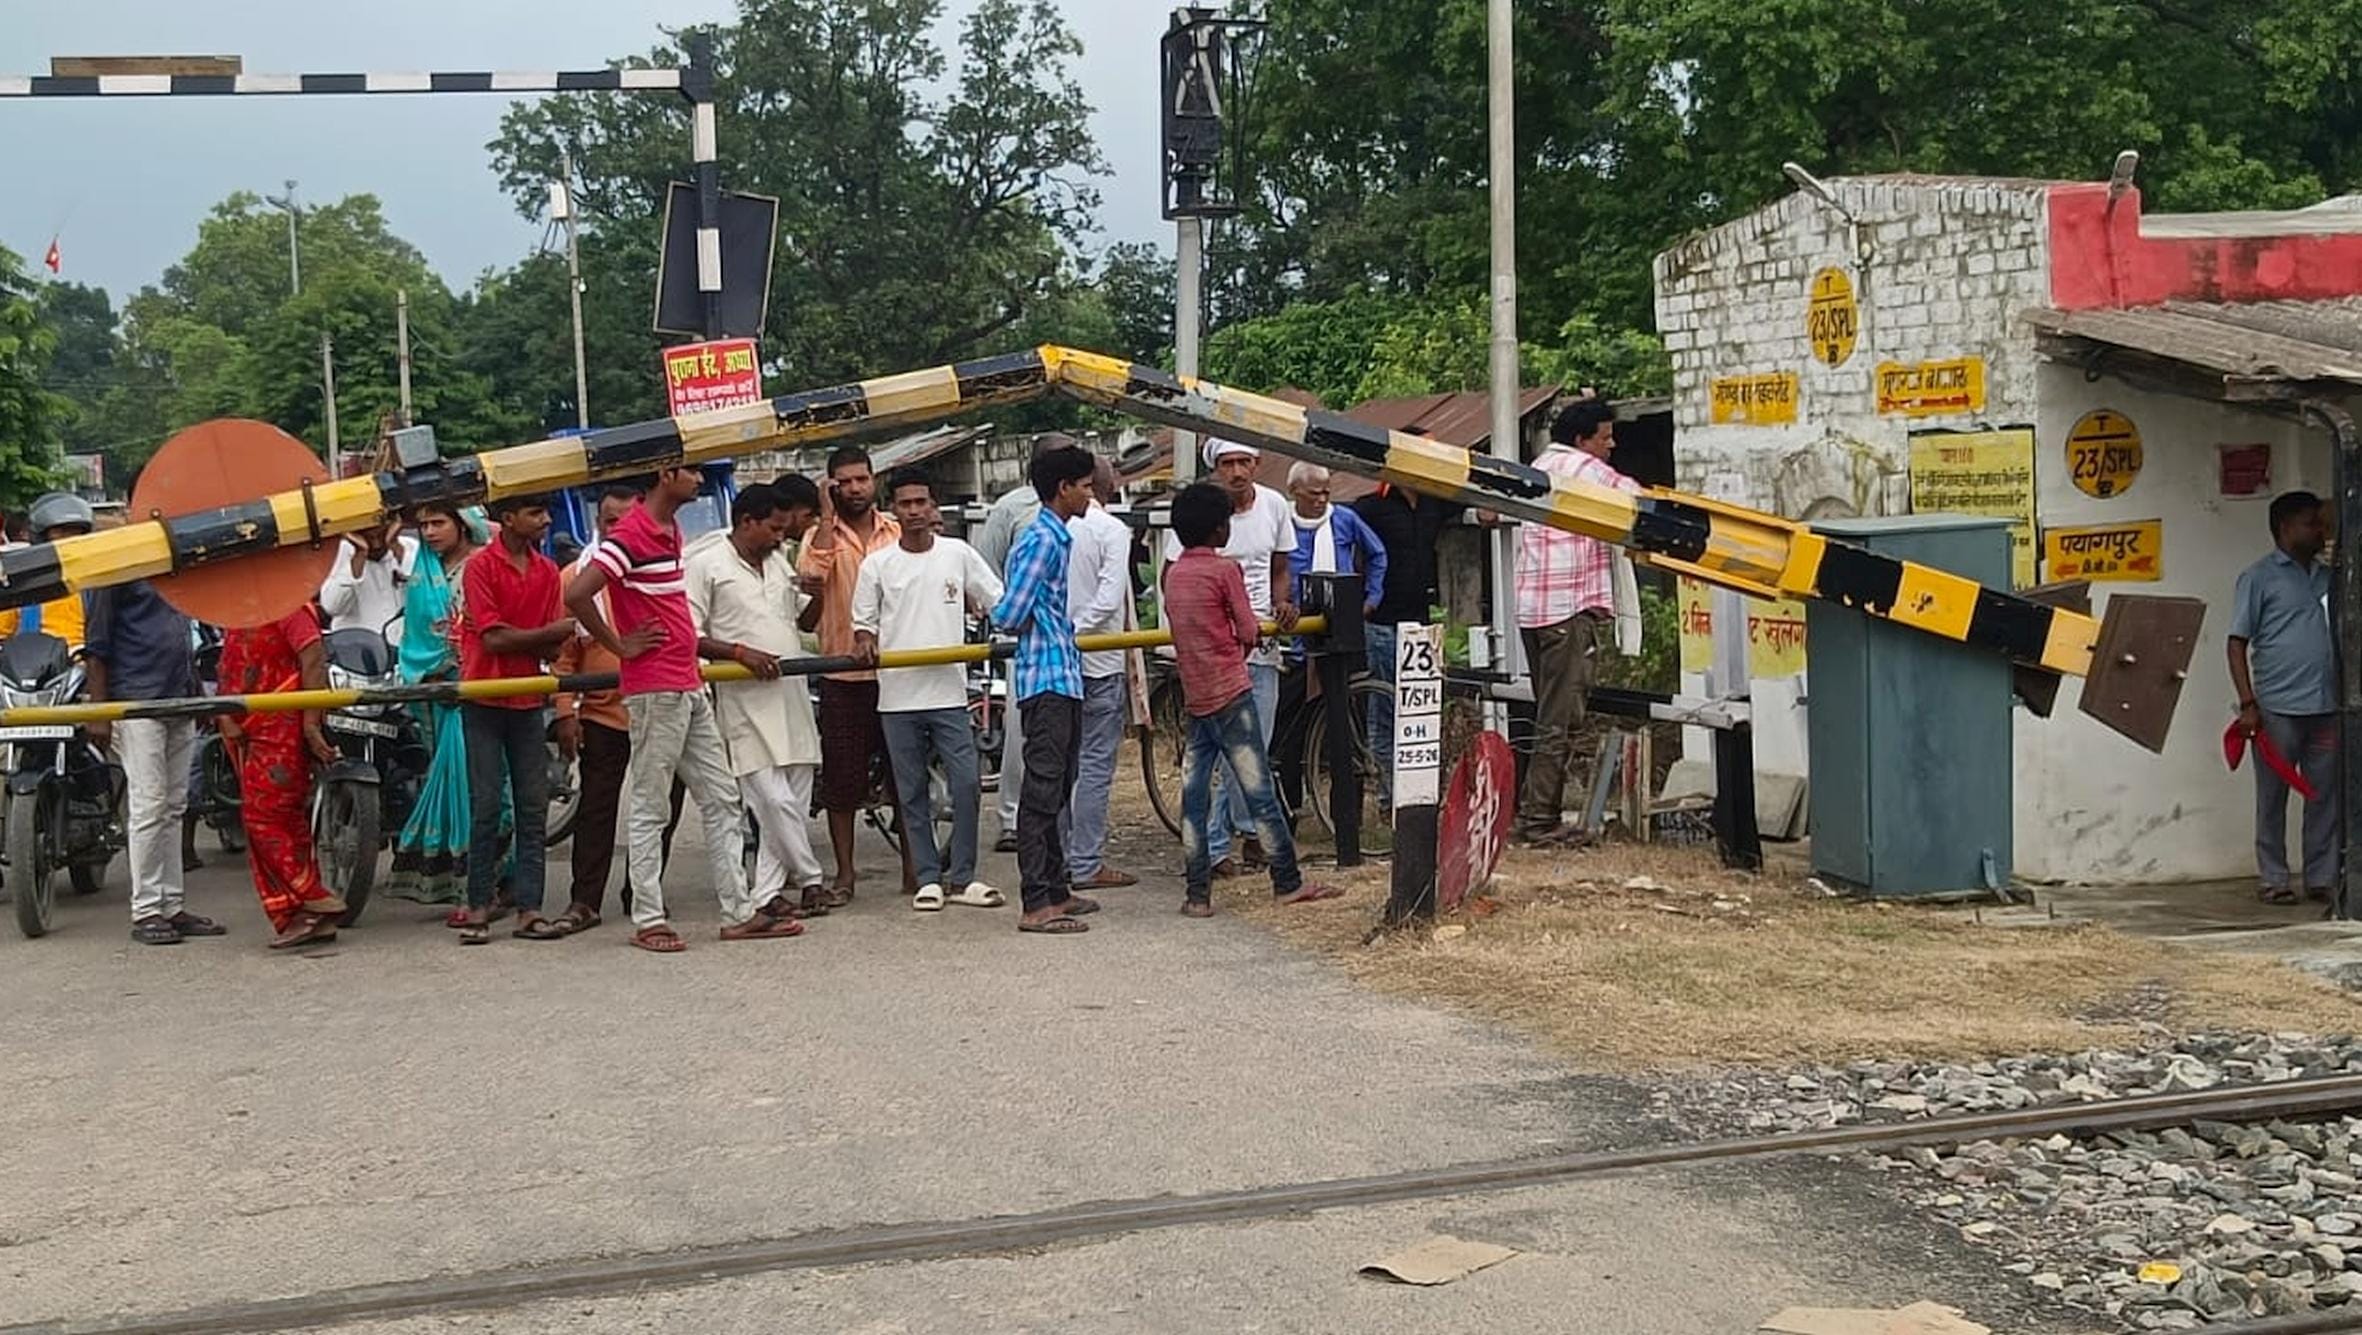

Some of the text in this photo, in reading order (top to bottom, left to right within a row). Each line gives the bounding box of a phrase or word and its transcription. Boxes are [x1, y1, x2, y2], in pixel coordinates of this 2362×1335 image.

[1812, 305, 1853, 341] 23/SPL
[2094, 416, 2110, 431] T
[2073, 446, 2137, 480] 23/SPL
[2060, 530, 2142, 560] पयागपुर
[1402, 641, 1433, 671] 23
[1401, 687, 1438, 707] T/SPL
